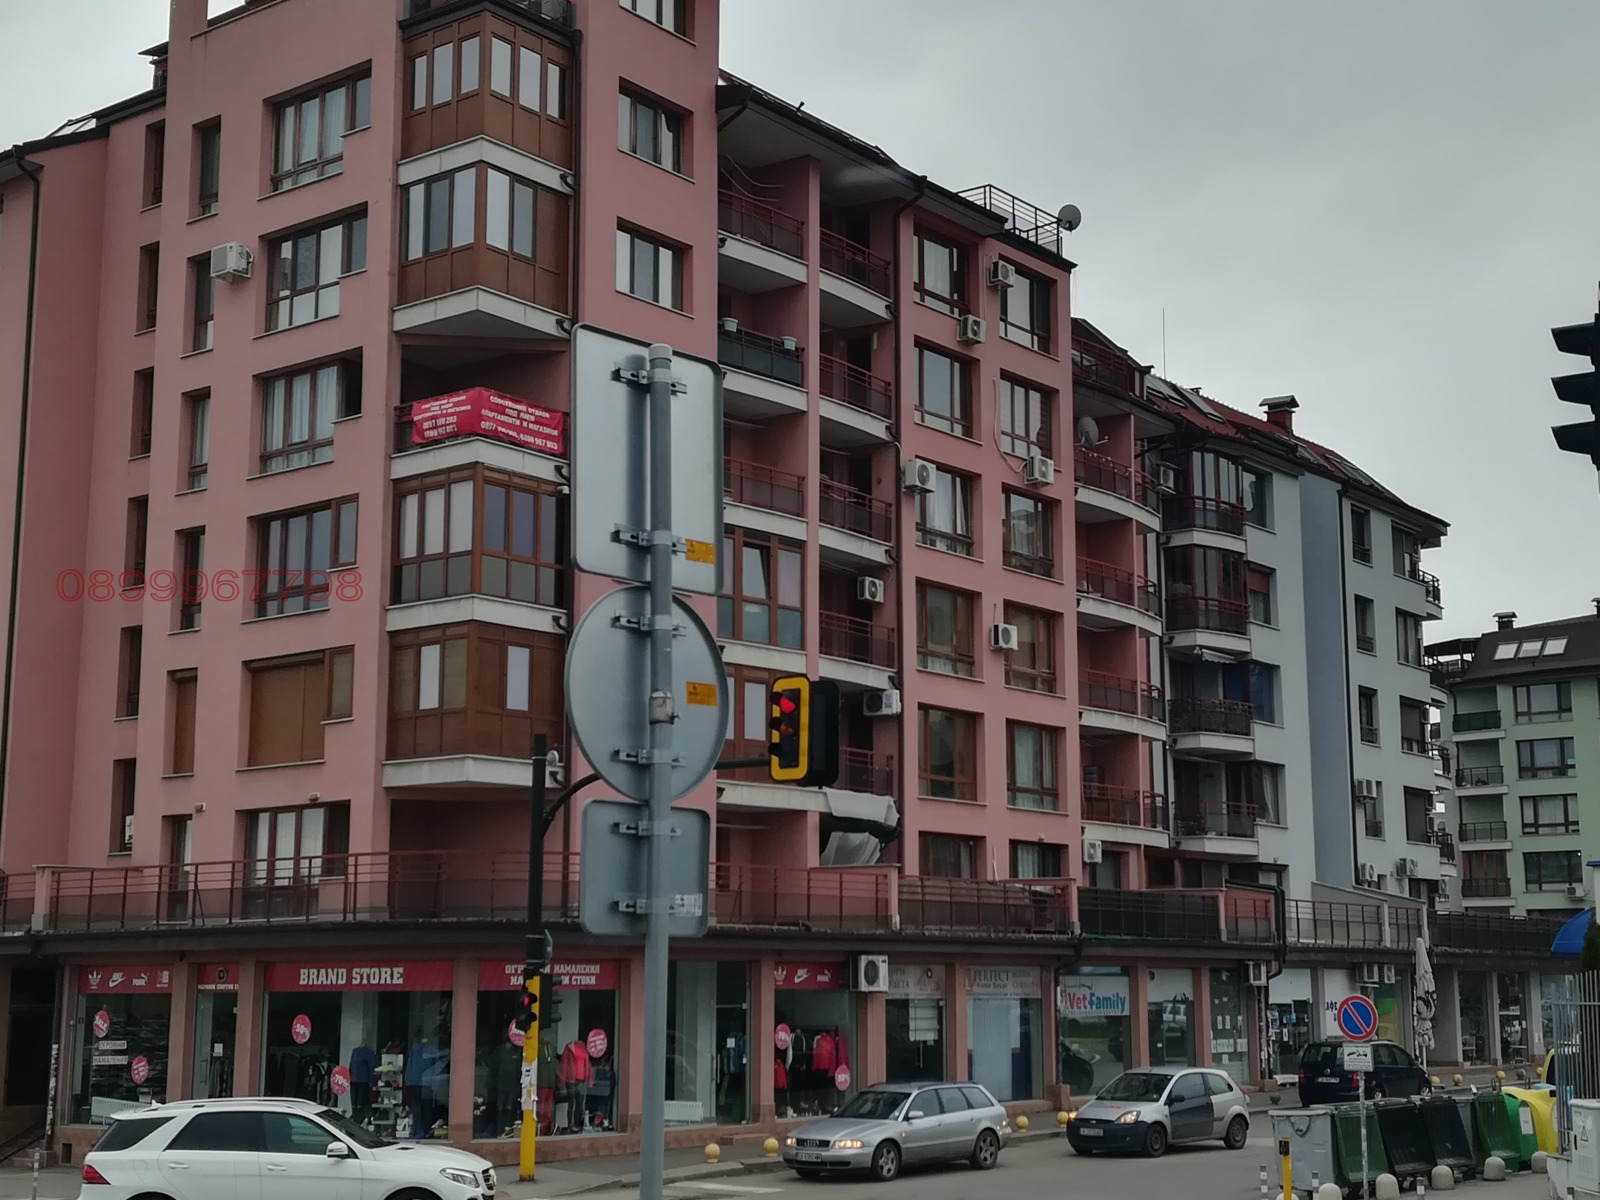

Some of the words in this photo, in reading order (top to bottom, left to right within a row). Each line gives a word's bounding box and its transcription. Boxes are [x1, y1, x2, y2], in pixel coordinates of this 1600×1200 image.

[299, 968, 347, 986] BRAND
[352, 967, 404, 985] STORE
[571, 975, 596, 985] СТОКИ
[973, 969, 1010, 982] PERFECT
